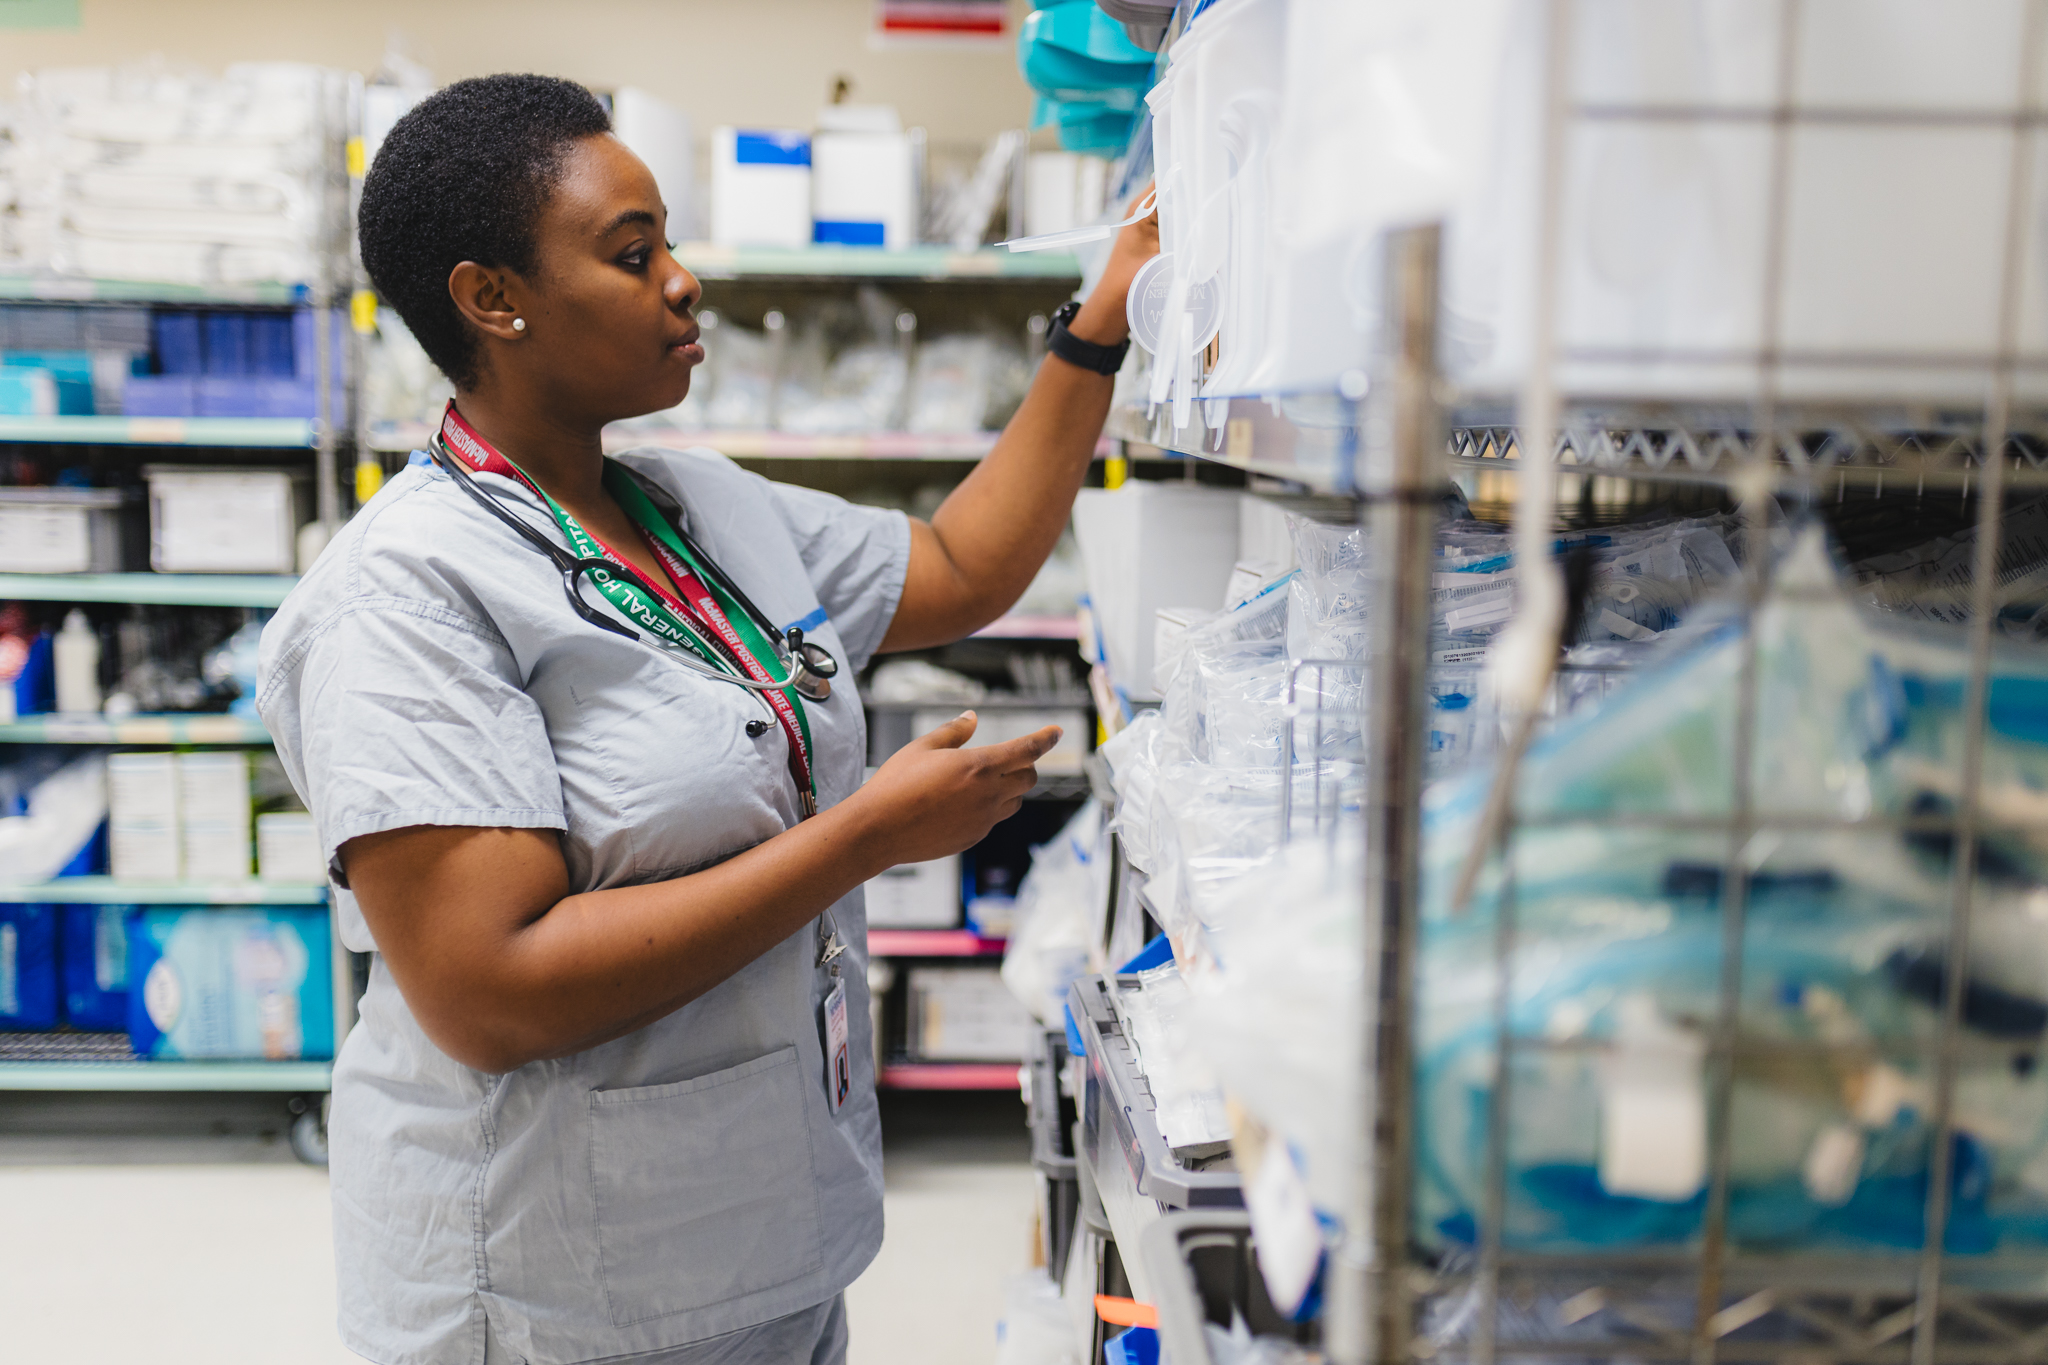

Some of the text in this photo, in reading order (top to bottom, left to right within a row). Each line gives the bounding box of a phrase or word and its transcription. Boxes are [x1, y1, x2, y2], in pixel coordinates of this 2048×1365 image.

[451, 424, 489, 467] McMASTER
[622, 588, 705, 659] GENERAL
[698, 597, 740, 645] McMASTER
[782, 706, 805, 755] MEDICAL
